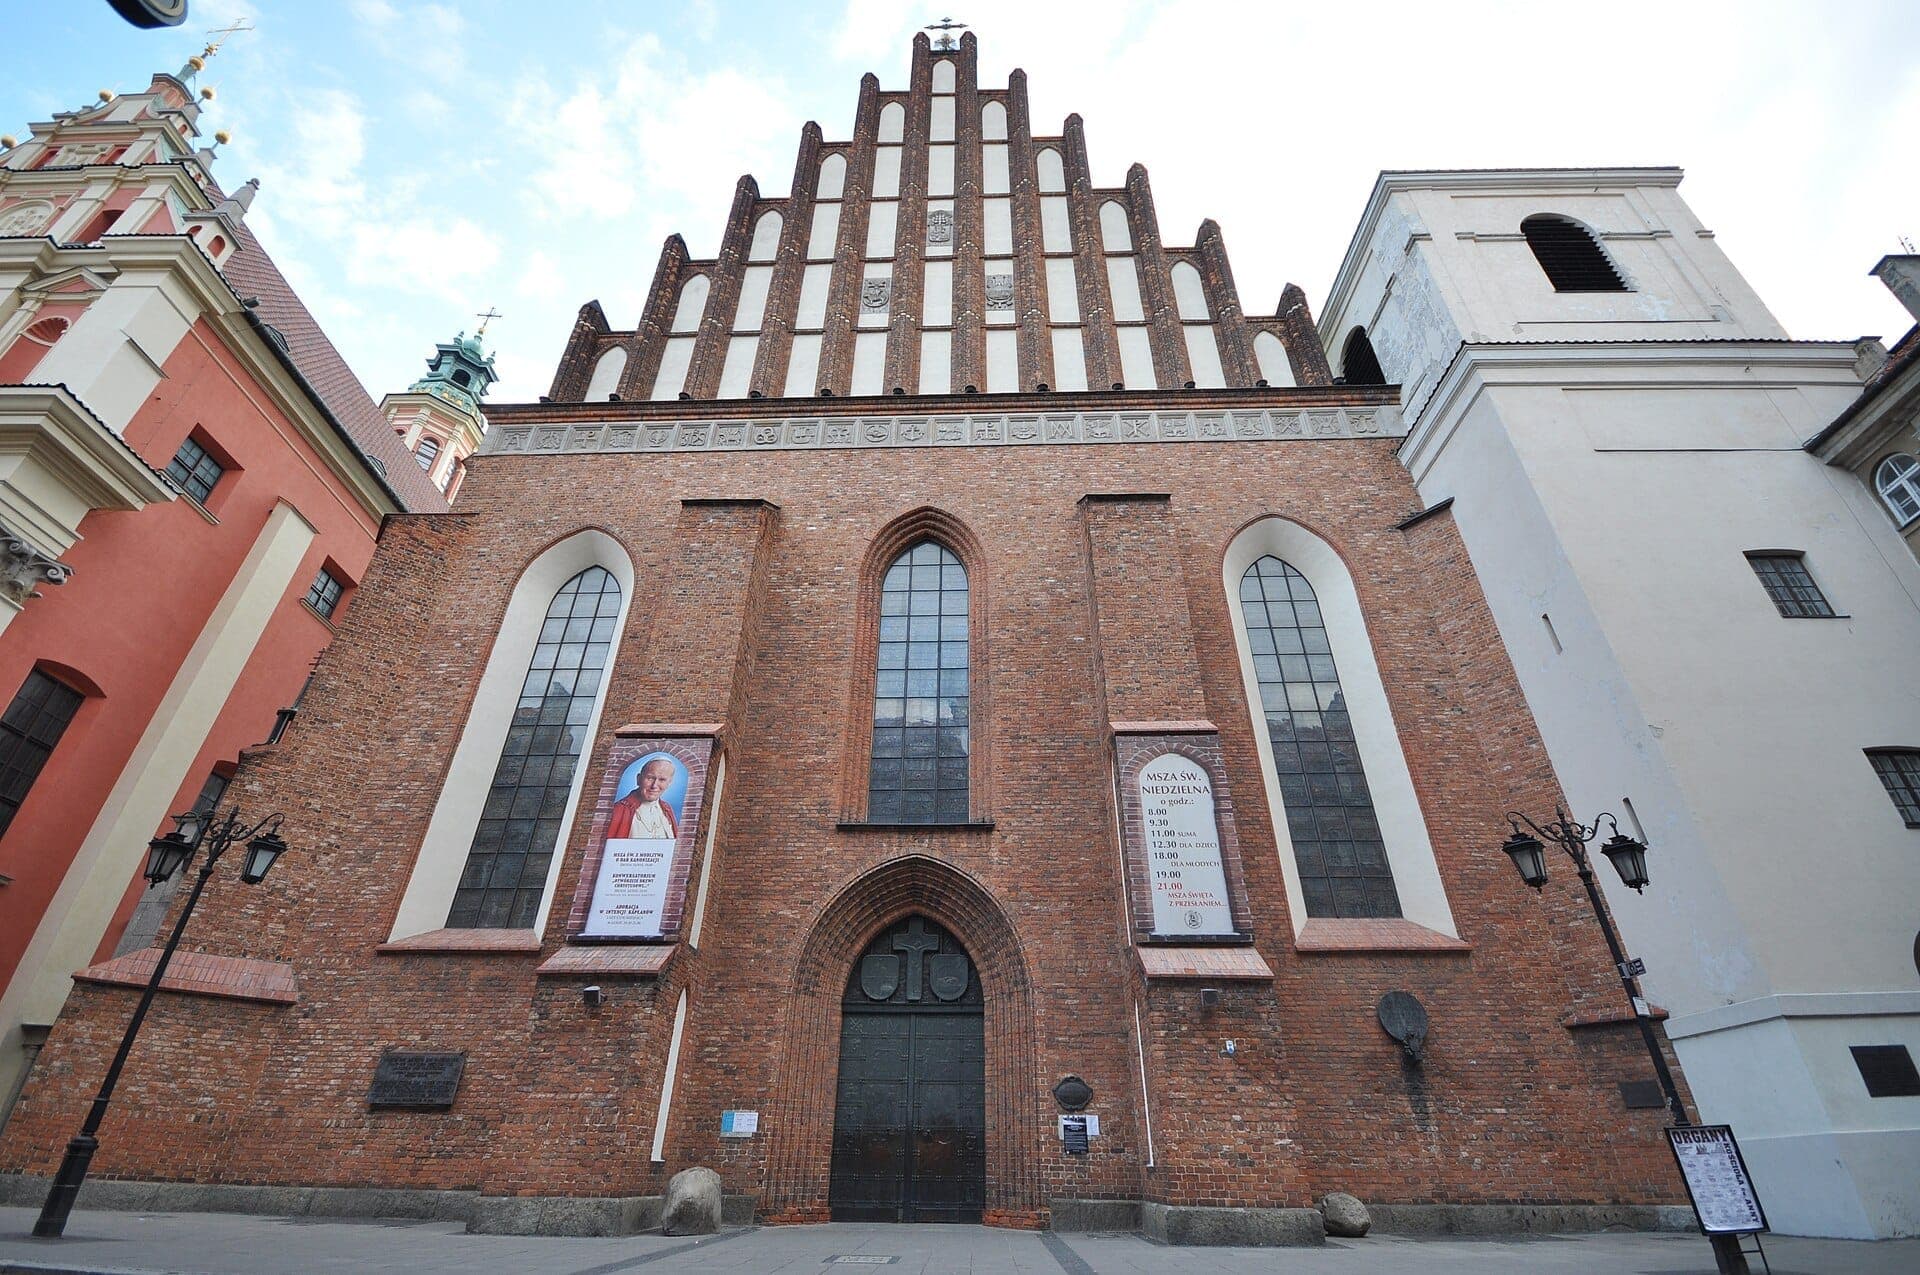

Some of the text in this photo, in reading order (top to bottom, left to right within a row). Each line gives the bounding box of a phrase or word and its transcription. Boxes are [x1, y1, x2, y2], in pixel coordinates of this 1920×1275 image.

[1146, 770, 1202, 781] MSZA ŚW.
[1142, 785, 1210, 794] NIEDZIELNA
[1148, 808, 1167, 816] 8.00
[1149, 819, 1169, 827] 9.30
[1151, 829, 1175, 838] 11.00
[1152, 841, 1177, 849] 12.30
[1154, 852, 1179, 860] 18.00
[1156, 870, 1181, 879] 19.00
[1157, 882, 1183, 890] 21.00
[1671, 1127, 1728, 1144] ORGANY
[1744, 1198, 1760, 1223] ANNY
